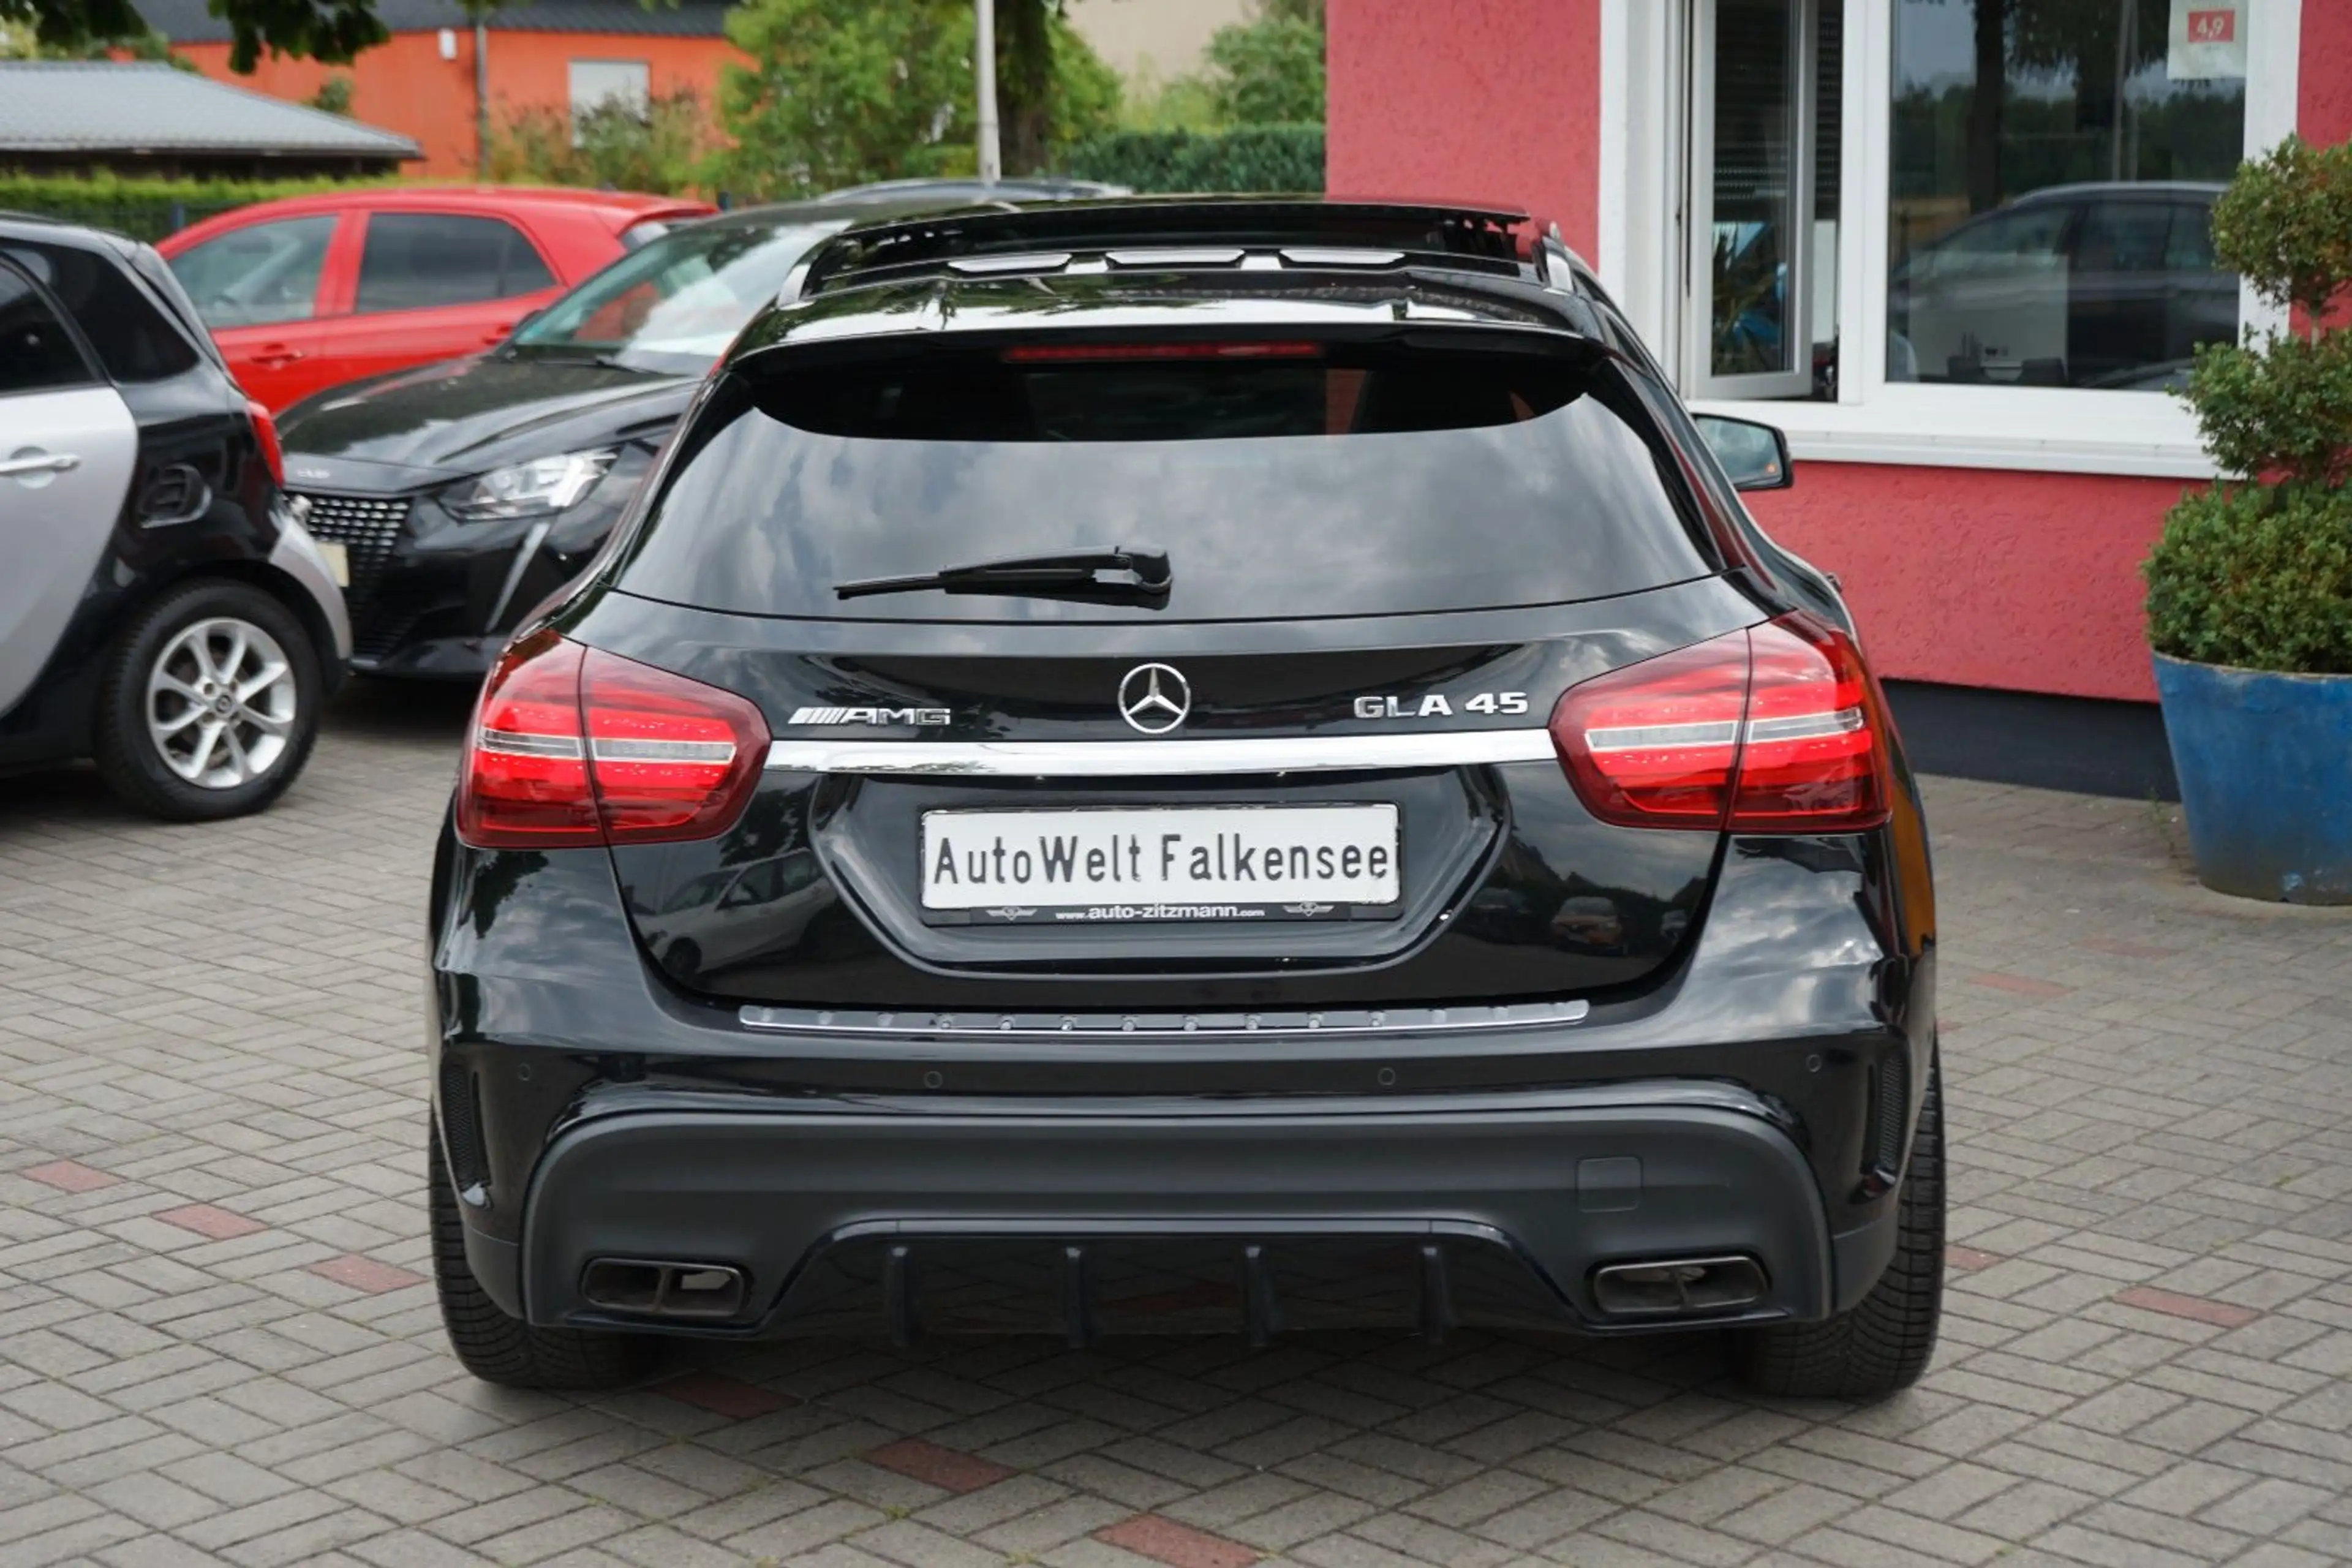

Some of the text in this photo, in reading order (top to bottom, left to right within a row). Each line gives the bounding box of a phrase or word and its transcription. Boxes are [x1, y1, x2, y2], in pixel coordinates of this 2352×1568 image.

[2197, 16, 2224, 39] 4,9
[840, 707, 951, 725] AMG
[1354, 692, 1528, 718] GLA 45
[933, 833, 1389, 884] AutoWelt Falkensee
[1055, 903, 1265, 919] www.auto-zitzmann.com
